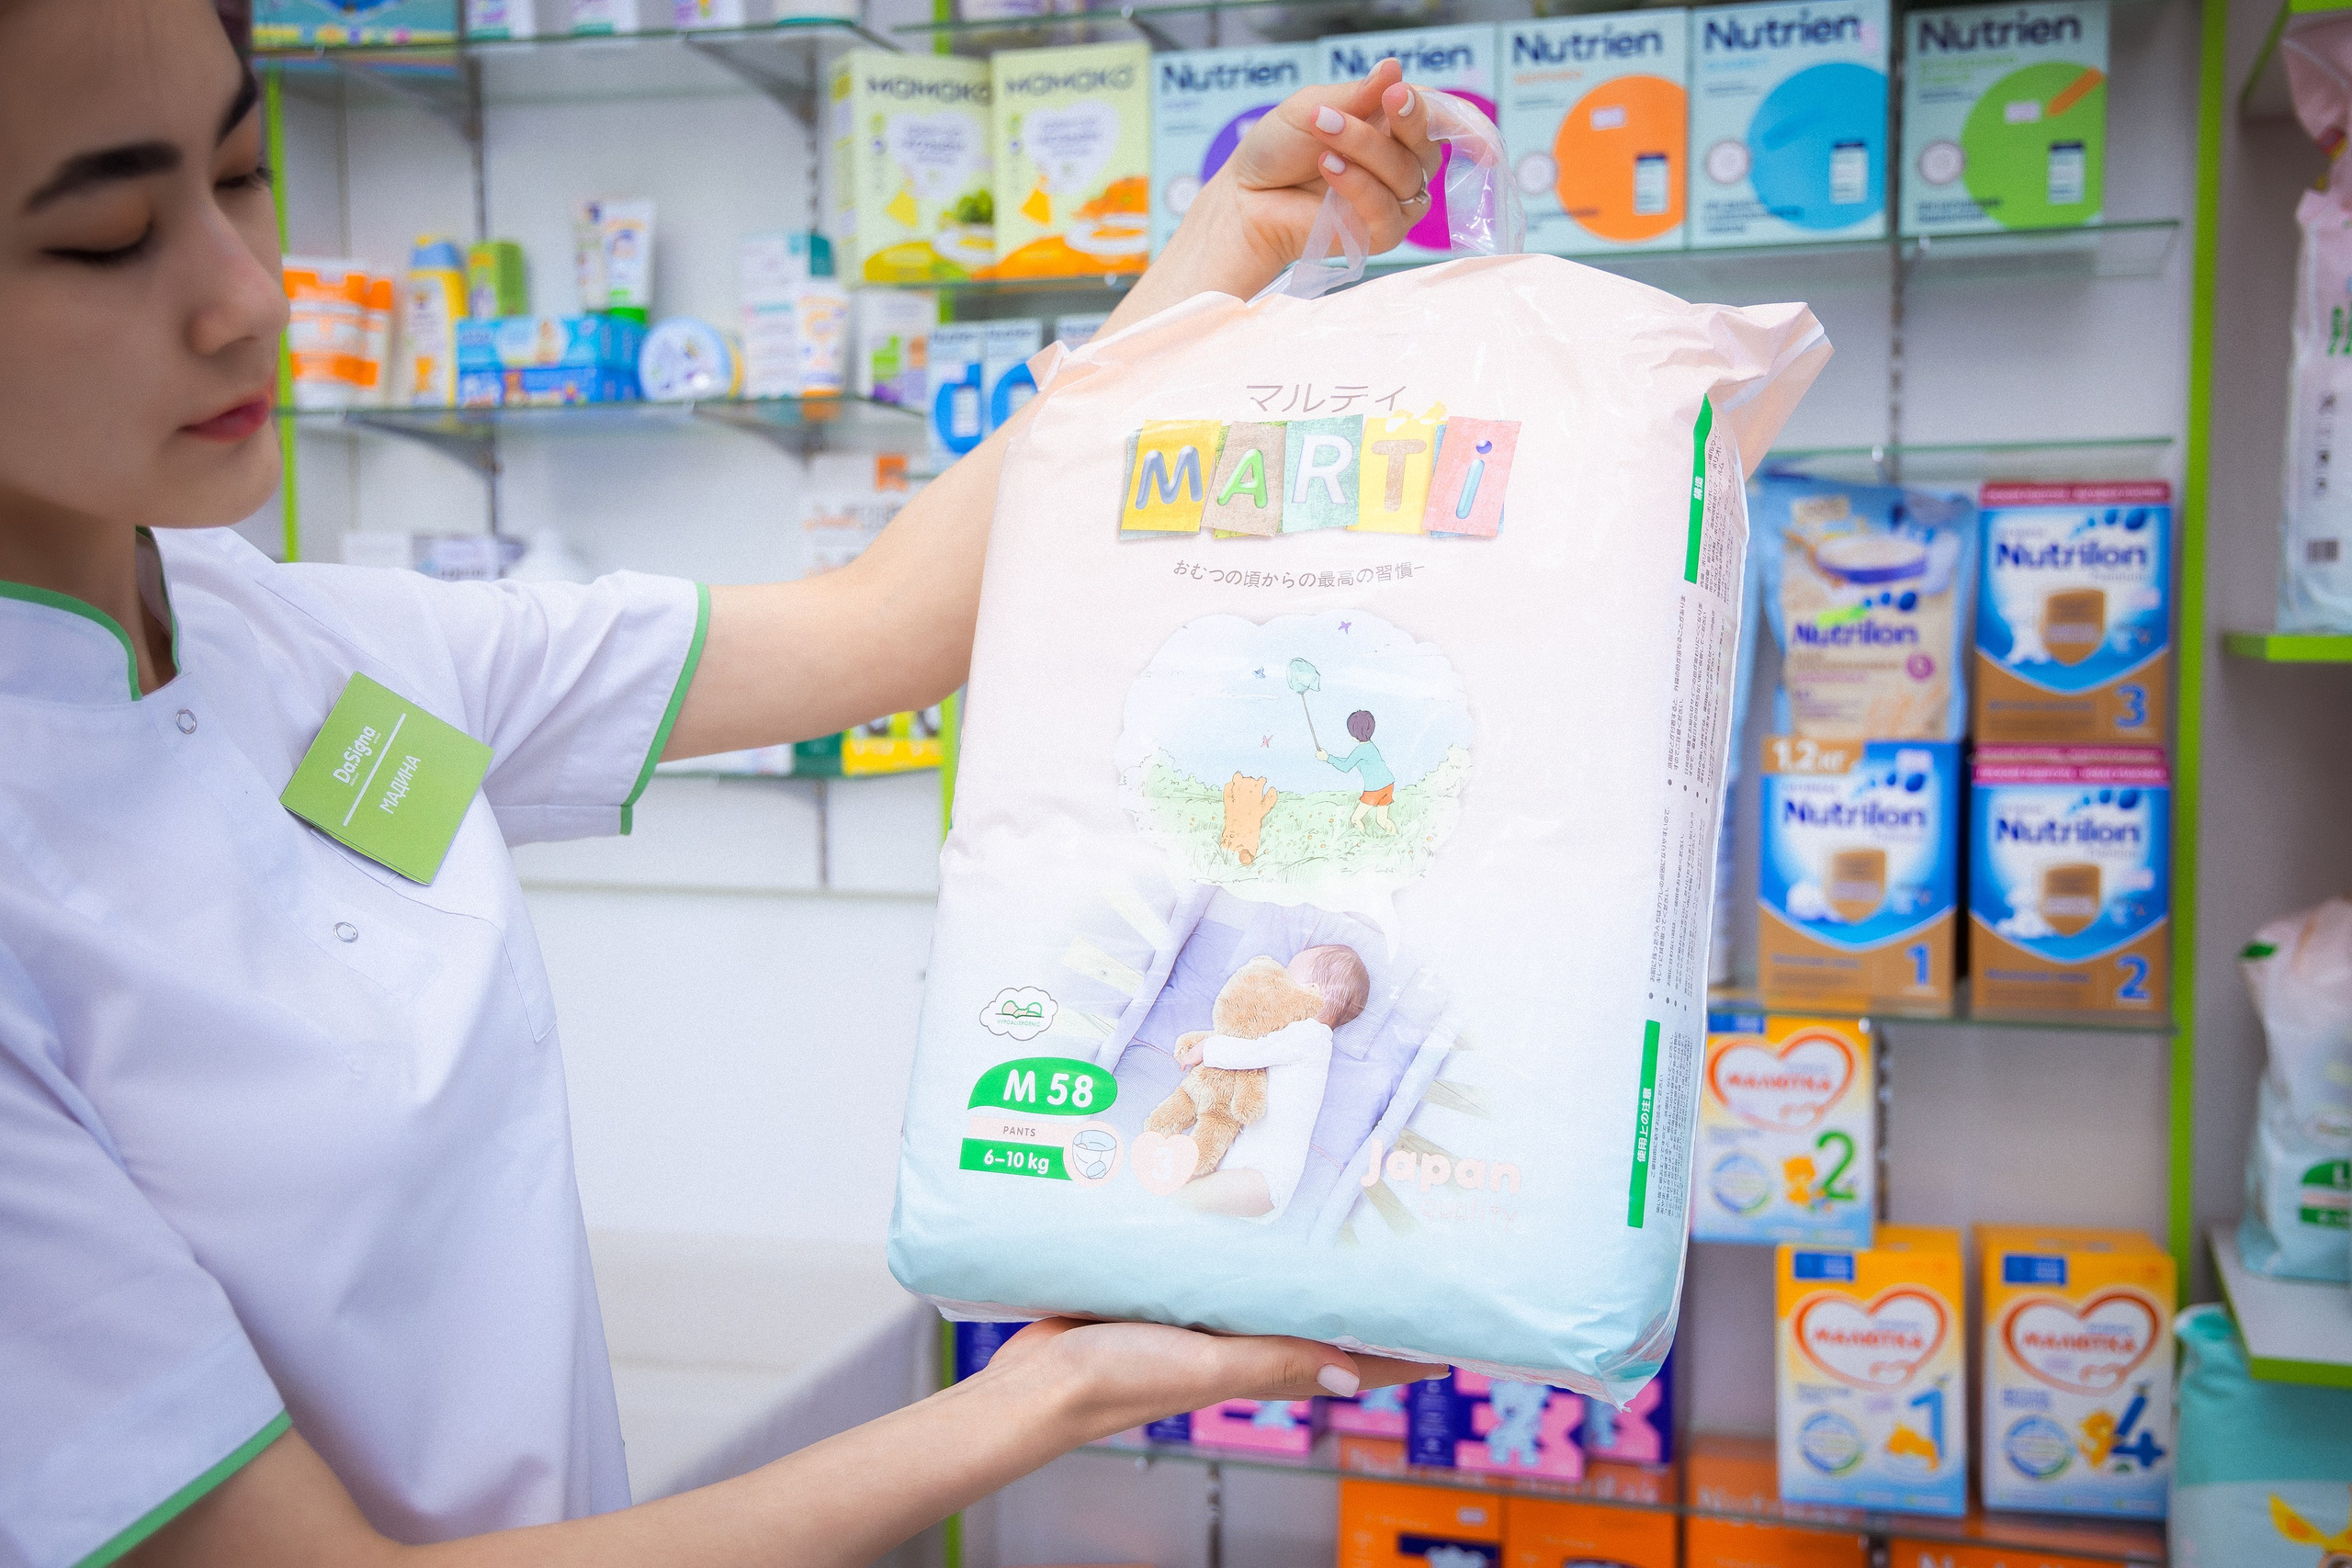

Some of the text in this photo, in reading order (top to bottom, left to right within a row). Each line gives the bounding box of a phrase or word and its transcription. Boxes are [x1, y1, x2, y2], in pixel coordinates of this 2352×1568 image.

[1513, 24, 1663, 65] Nutrien
[1706, 7, 1860, 53] Nutrien
[1917, 8, 2082, 55] Nutrien
[1245, 382, 1408, 413] マルティ
[1995, 540, 2147, 570] Nutrilon
[1792, 619, 1918, 647] Nutrilon
[2115, 682, 2148, 728] 3
[379, 755, 422, 815] МАДИНА
[1783, 799, 1927, 829] Nutrilon
[1996, 818, 2141, 844] Nutrilon
[1905, 942, 1930, 986] 1
[2117, 953, 2151, 999] 2
[996, 1019, 1041, 1028] HYPOALLERGENIC
[1003, 1068, 1093, 1108] M 58
[1002, 1125, 1036, 1137] PANTS
[1636, 1087, 1652, 1163] 使用上の注意
[1027, 1152, 1050, 1175] kg
[1360, 1137, 1521, 1194] Japan
[1815, 1131, 1856, 1201] 2
[1420, 1197, 1518, 1233] quality
[1910, 1388, 1945, 1461] 1
[2112, 1393, 2166, 1469] 4
